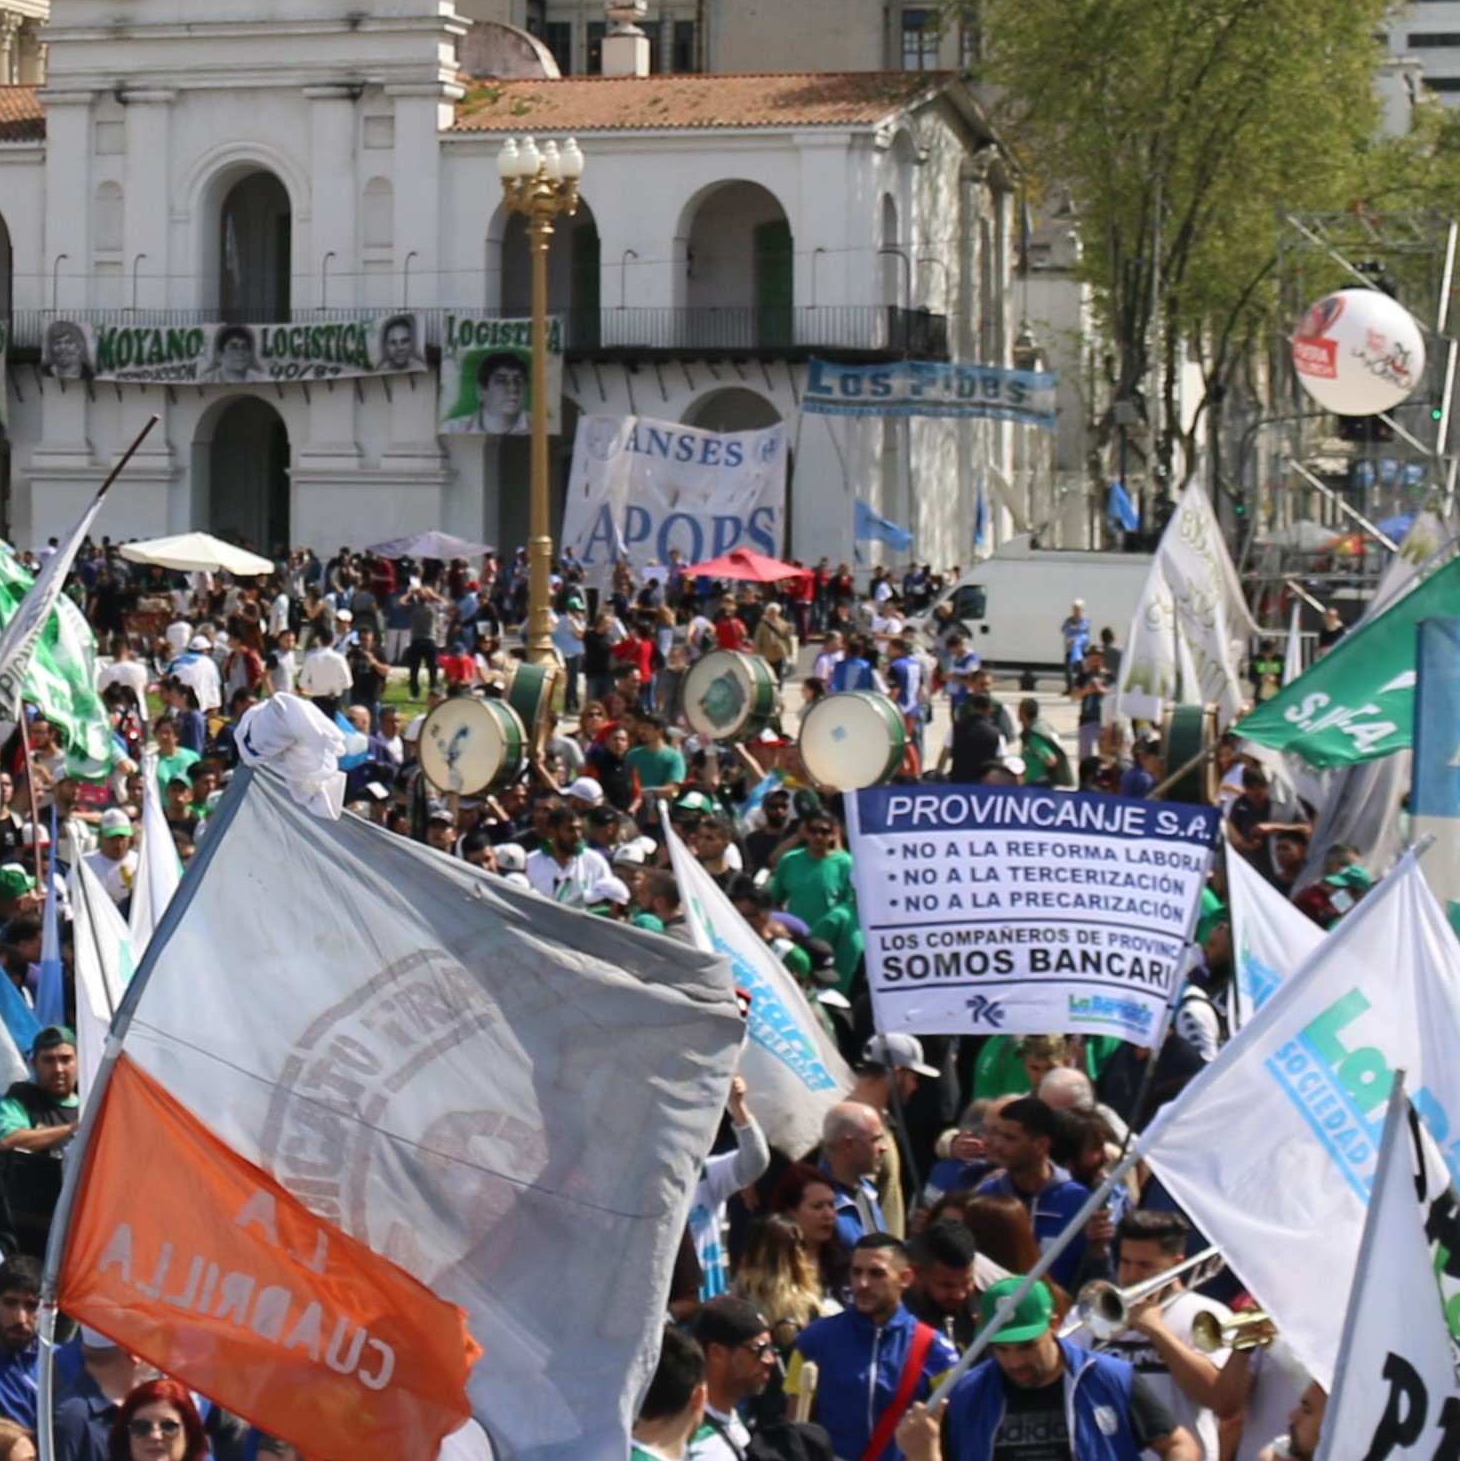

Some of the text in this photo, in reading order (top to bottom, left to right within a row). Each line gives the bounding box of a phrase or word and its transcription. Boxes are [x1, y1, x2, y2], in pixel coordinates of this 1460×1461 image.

[96, 324, 374, 374] MOYANO LOGISTICA
[445, 316, 563, 355] LOGISTIA
[807, 357, 893, 399] Los
[625, 426, 744, 468] ANSES
[885, 794, 1213, 841] PROVINCANJE S.A.
[902, 843, 936, 860] NO
[945, 842, 961, 857] A
[969, 842, 998, 858] LA
[1007, 842, 1119, 863] REFORMA
[903, 866, 1185, 896] NO A LA TERCERIZACIÓN
[905, 891, 1185, 924] NO A LA PRECARIZACIÓN
[880, 934, 919, 951] LOS
[926, 926, 1070, 948] COMPAÑEROS
[1078, 929, 1102, 945] DE
[882, 948, 1172, 990] SOMOS BANCARI
[1273, 1040, 1372, 1167] SOCIEDAD
